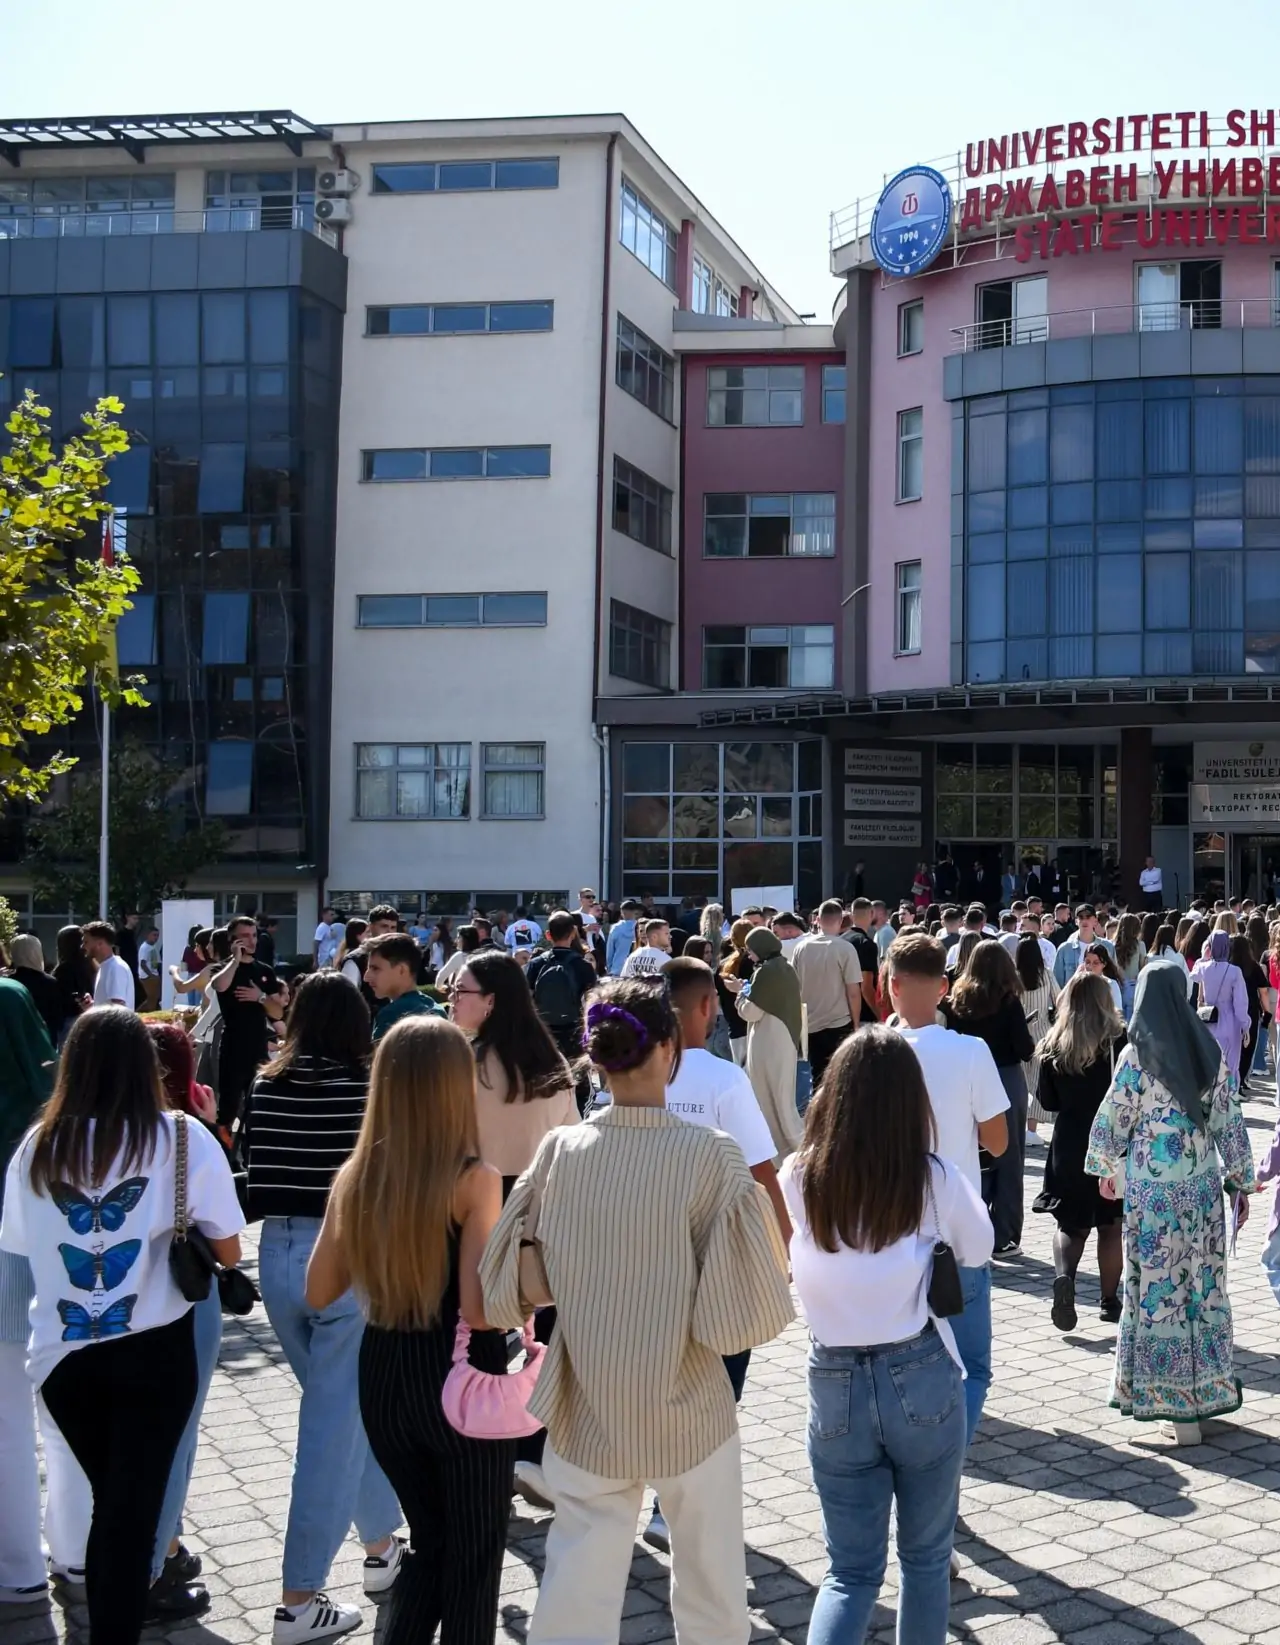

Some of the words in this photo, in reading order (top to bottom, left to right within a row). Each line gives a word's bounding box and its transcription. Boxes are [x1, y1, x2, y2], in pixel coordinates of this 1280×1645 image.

[965, 110, 1209, 178] UNIVERSITETI
[960, 163, 1137, 232] ДРЖАВЕН
[899, 230, 919, 244] 1994
[1015, 211, 1123, 263] STATE
[1206, 758, 1267, 767] UNIVERSITETI
[668, 1102, 705, 1114] UTURE
